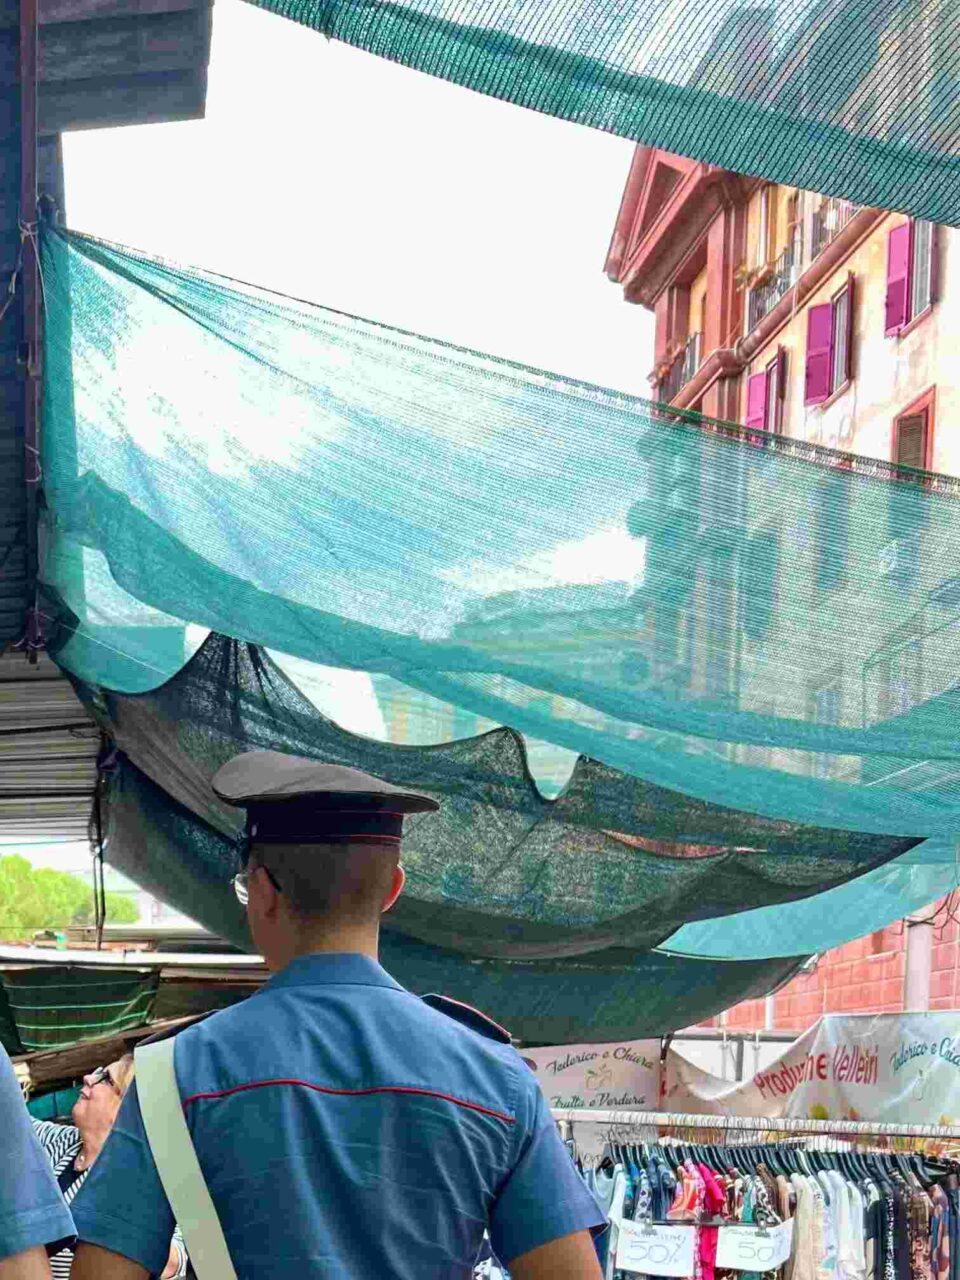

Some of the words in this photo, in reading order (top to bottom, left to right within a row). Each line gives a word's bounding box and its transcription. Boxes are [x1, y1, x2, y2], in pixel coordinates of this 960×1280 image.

[545, 1053, 599, 1076] Federico
[613, 1046, 655, 1069] Chiara
[551, 1095, 585, 1109] Frutta
[597, 1092, 646, 1106] Verdura
